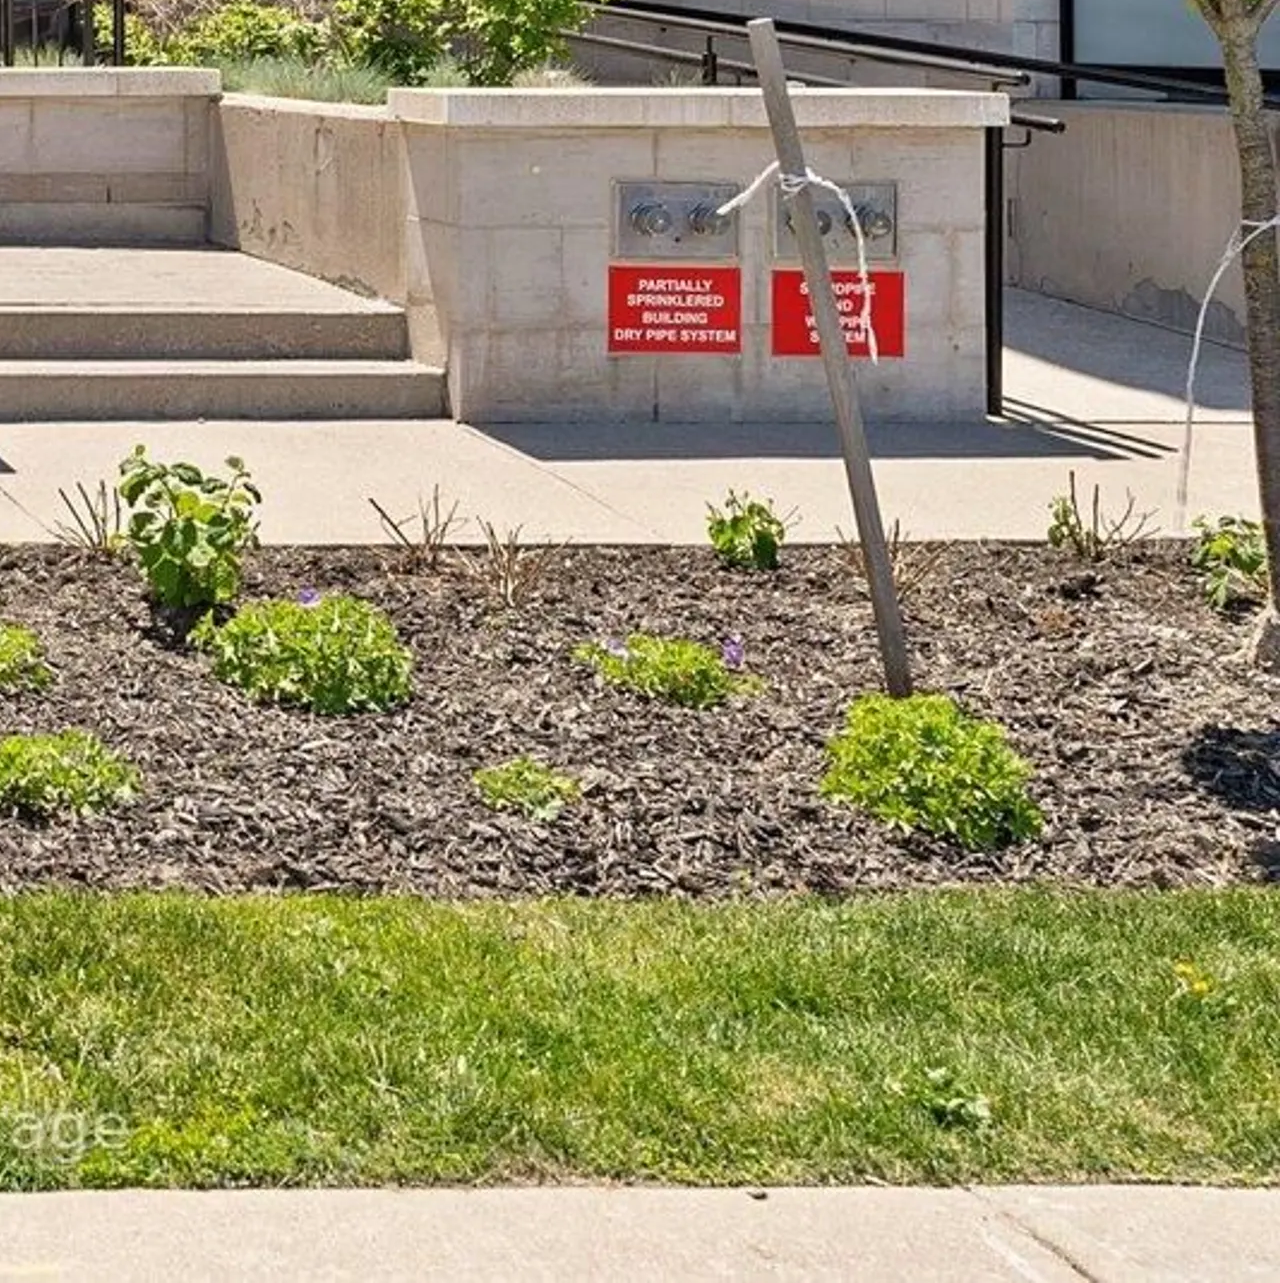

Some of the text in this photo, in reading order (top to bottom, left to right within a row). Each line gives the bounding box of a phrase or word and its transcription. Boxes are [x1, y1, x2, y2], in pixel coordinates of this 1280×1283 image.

[638, 278, 713, 292] PARTIALLY
[627, 293, 724, 307] SPRINKLERED
[642, 311, 708, 324] BUILDING
[614, 328, 736, 342] DRY PIPE SYSTEM
